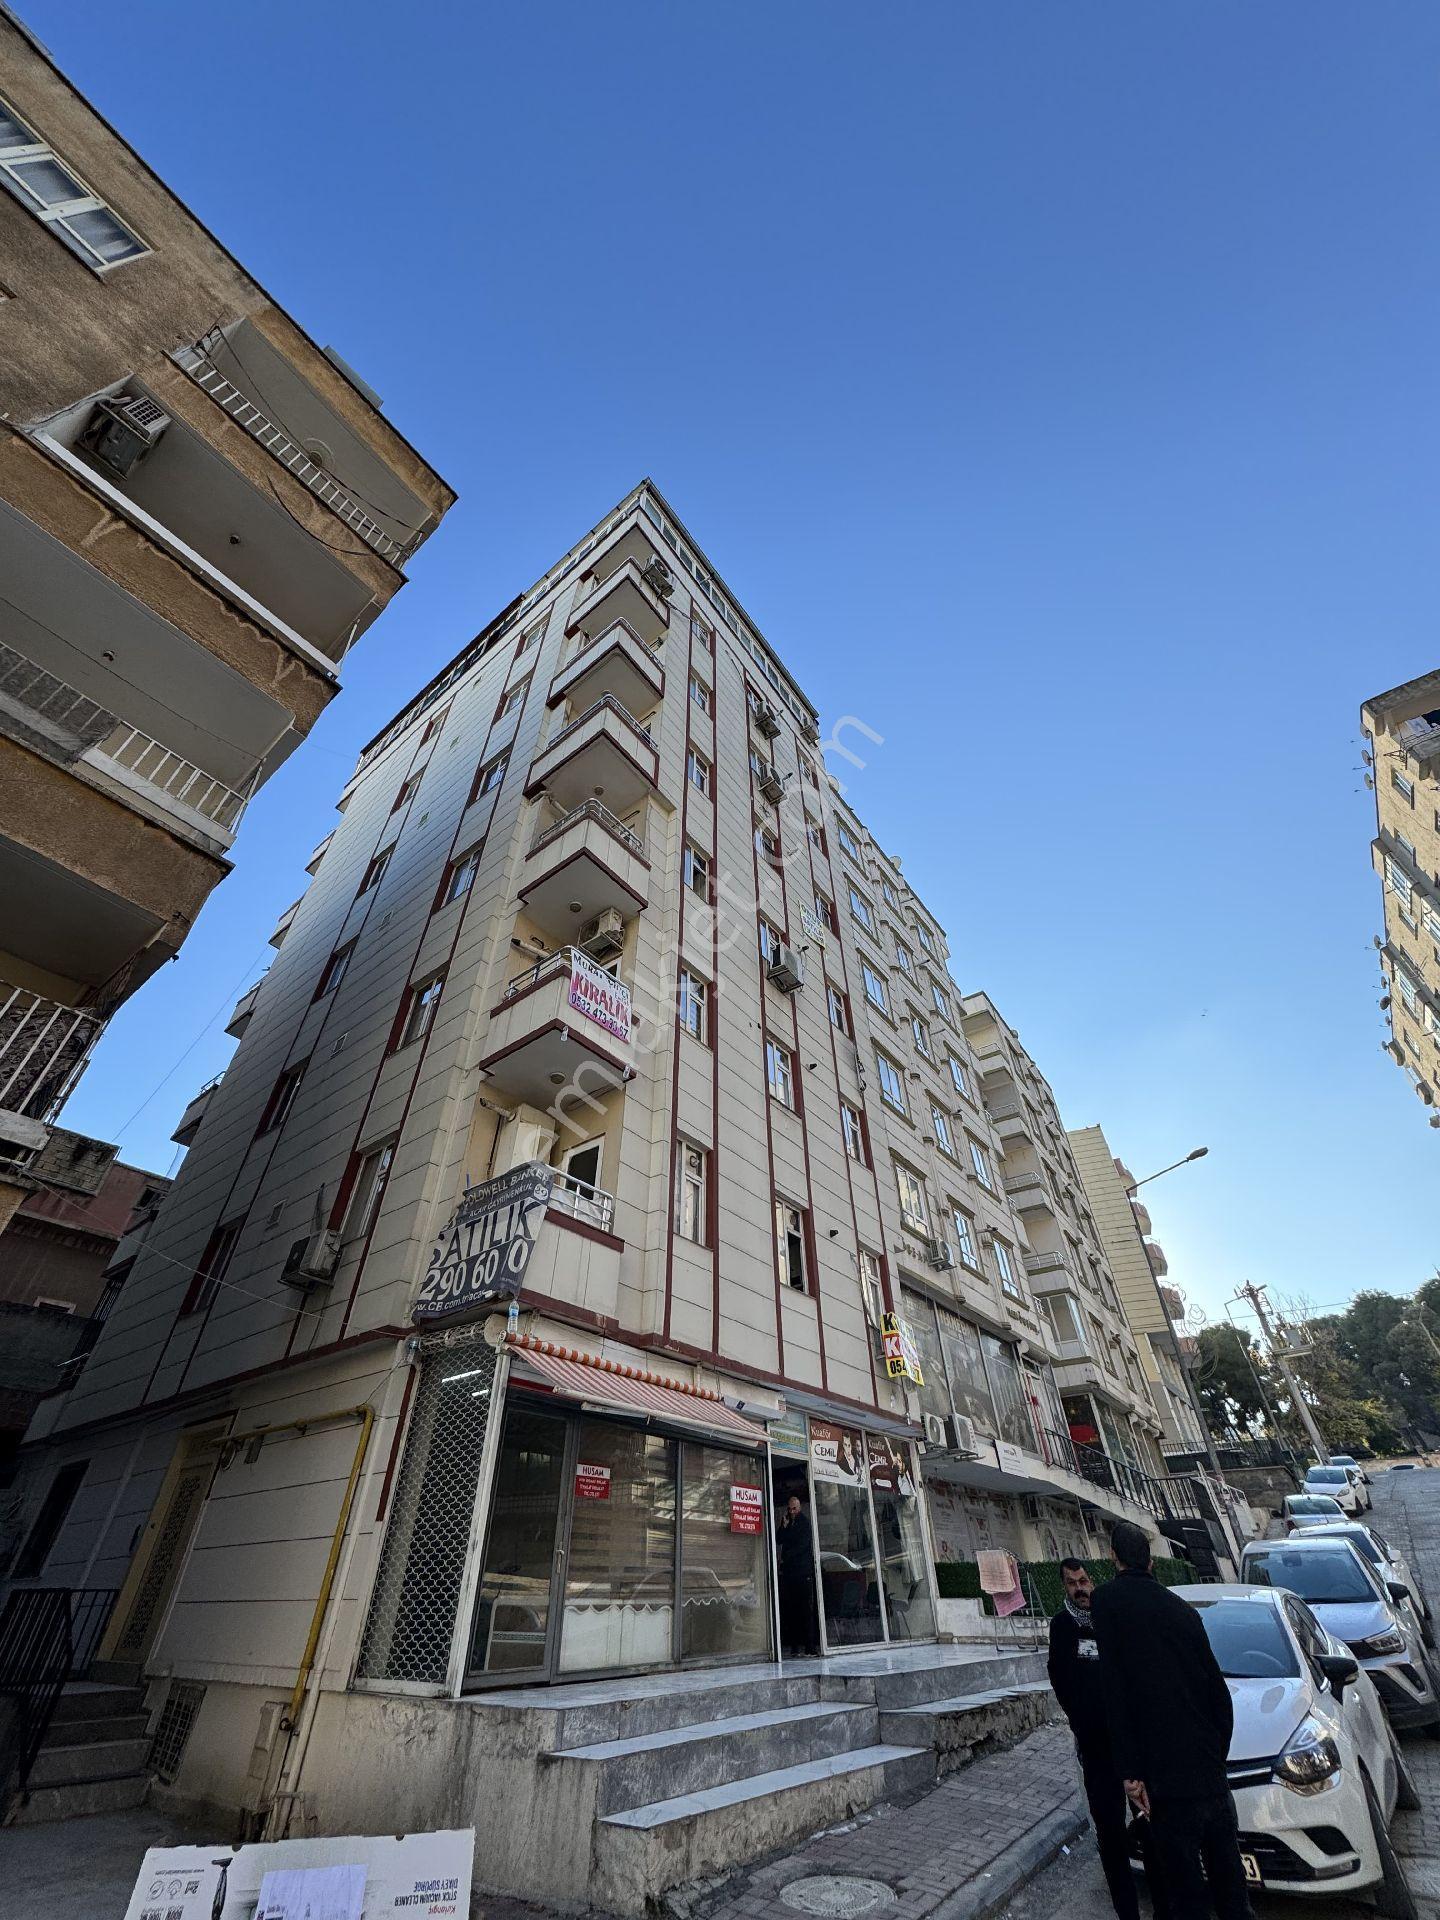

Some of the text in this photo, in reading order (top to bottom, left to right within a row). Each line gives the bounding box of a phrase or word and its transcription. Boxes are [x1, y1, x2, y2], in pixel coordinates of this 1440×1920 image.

[571, 970, 630, 1027] KİRALIK
[571, 993, 591, 1014] 0532
[593, 1008, 607, 1024] 473
[510, 1168, 549, 1187] BANKER
[420, 1261, 467, 1300] 290
[471, 1249, 499, 1289] 60
[582, 1465, 604, 1477] HUSAM
[735, 1490, 758, 1502] HUSAM
[395, 1895, 419, 1906] CLEANER
[442, 1890, 458, 1902] STICK
